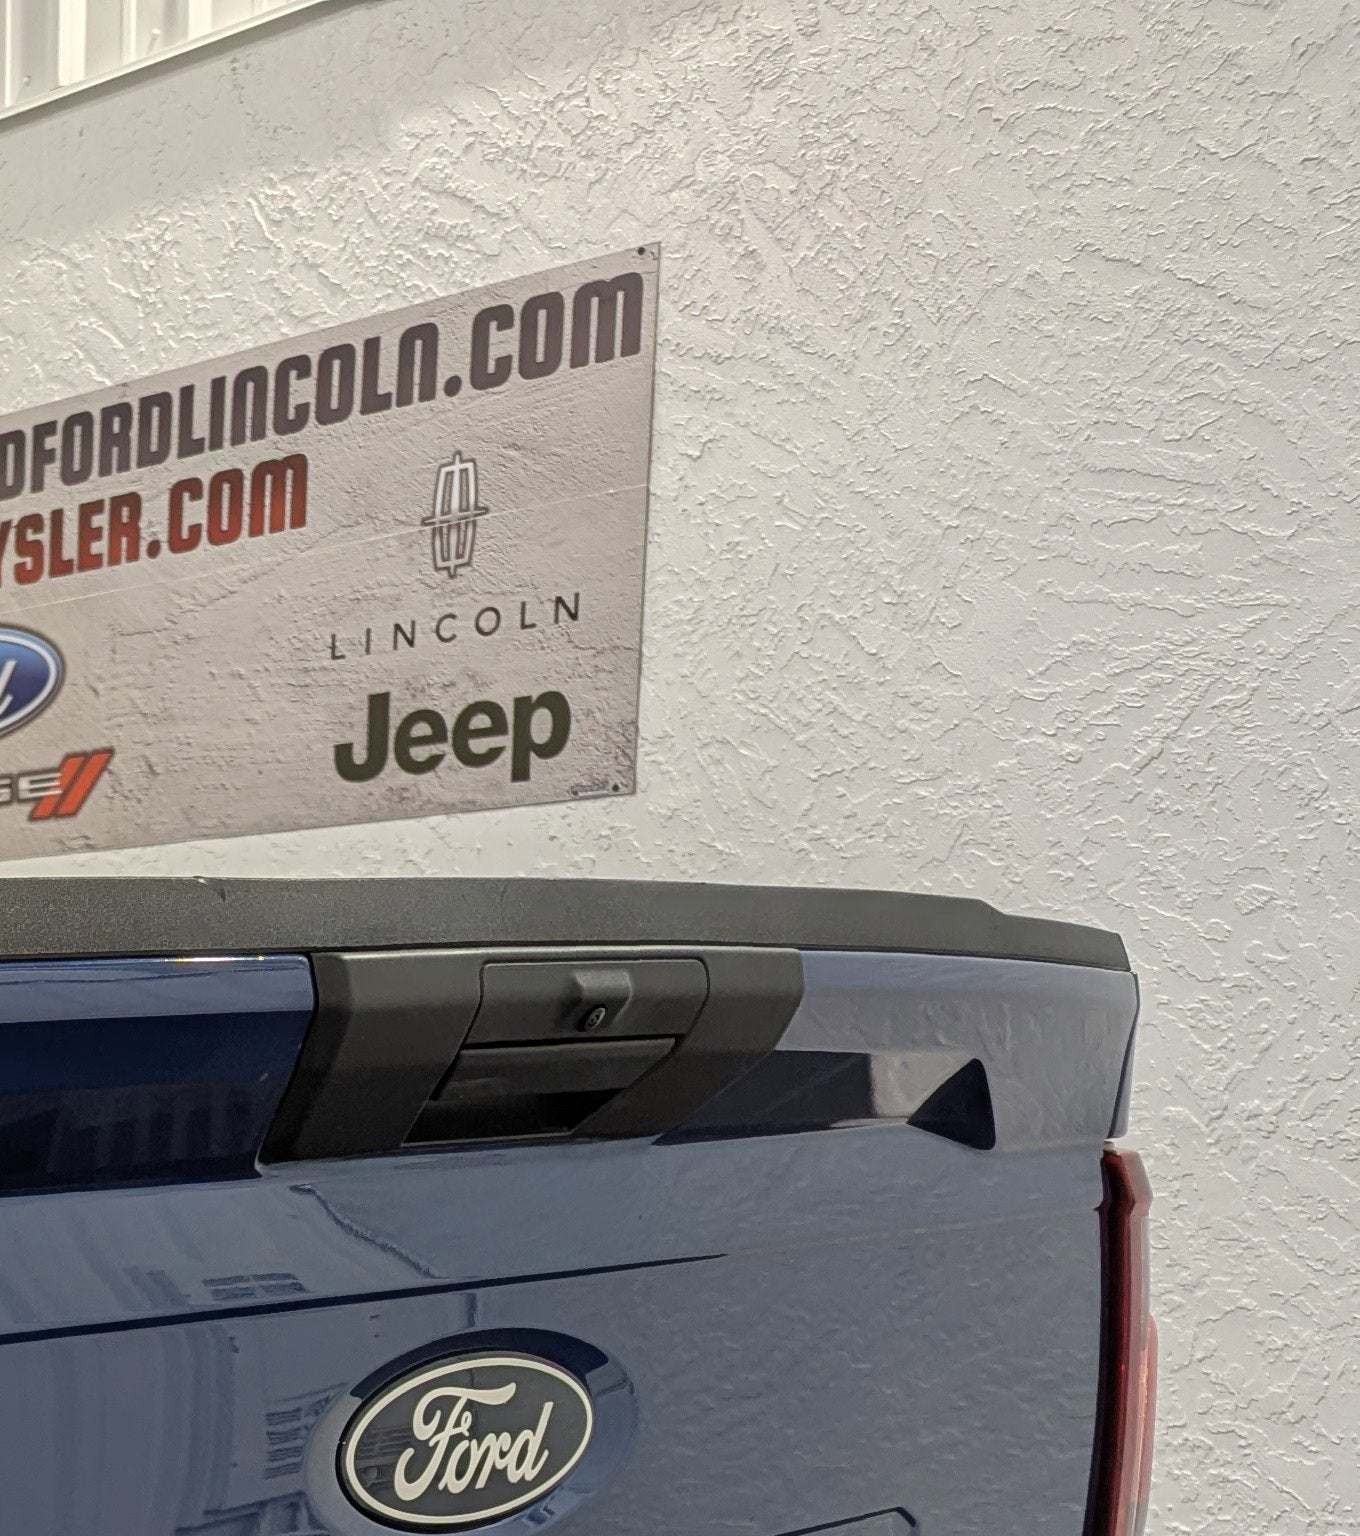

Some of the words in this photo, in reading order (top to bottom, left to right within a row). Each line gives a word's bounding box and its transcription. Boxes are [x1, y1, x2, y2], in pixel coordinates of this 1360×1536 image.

[330, 592, 580, 660] LINCOLN
[333, 689, 573, 783] Jeep
[394, 1382, 554, 1502] Ford
